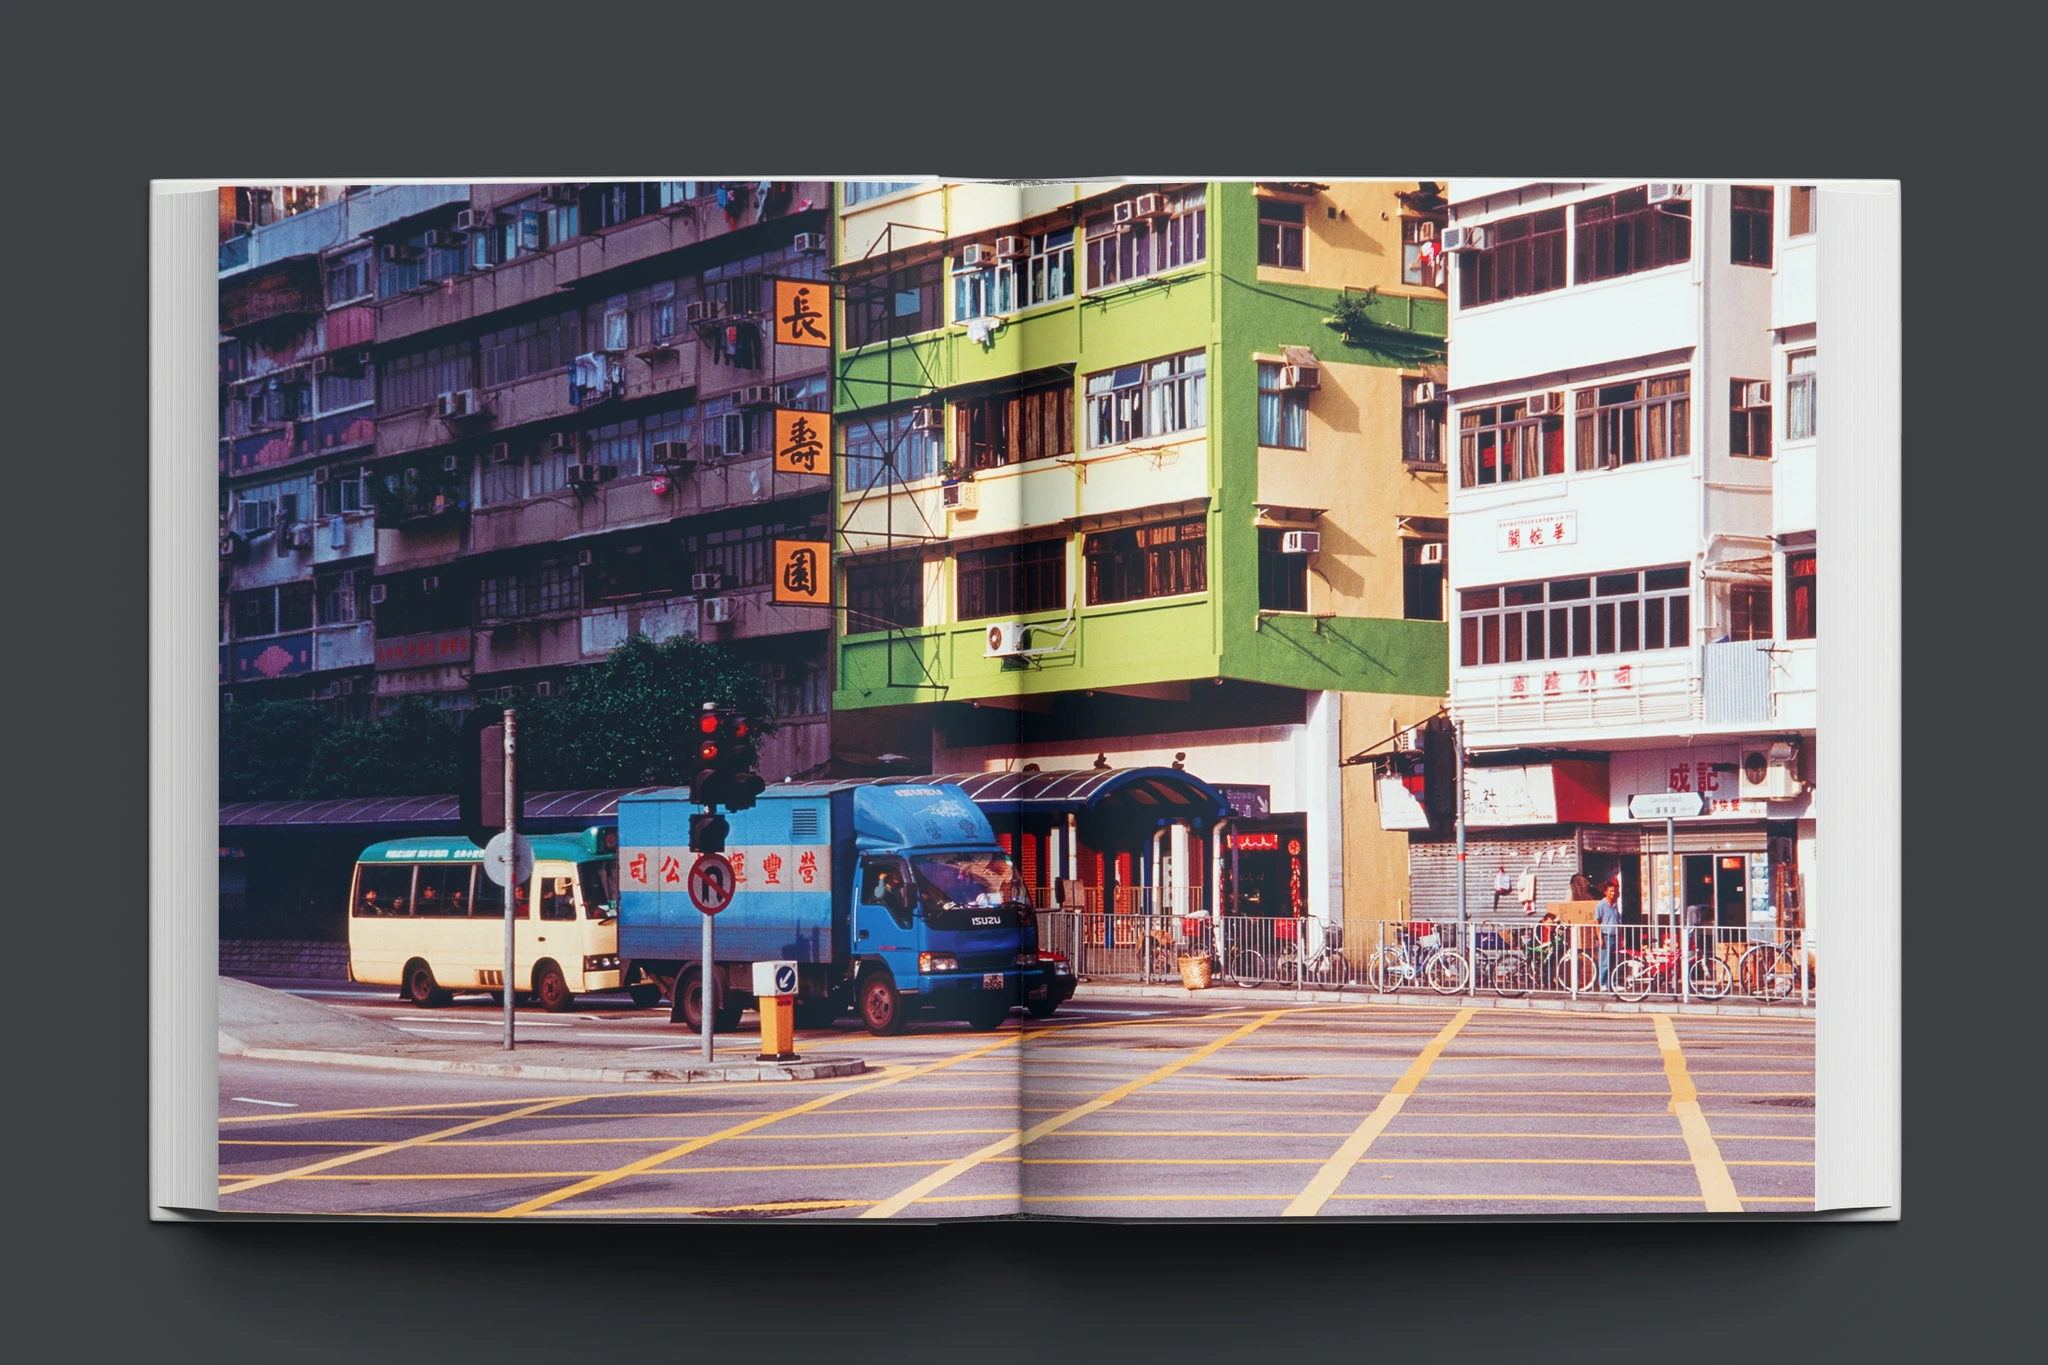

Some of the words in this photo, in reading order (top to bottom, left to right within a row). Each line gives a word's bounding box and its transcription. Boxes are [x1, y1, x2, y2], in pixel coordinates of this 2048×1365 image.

[1669, 763, 1719, 792] 成記
[1226, 789, 1256, 802] Subway
[972, 916, 1001, 925] ISUZU
